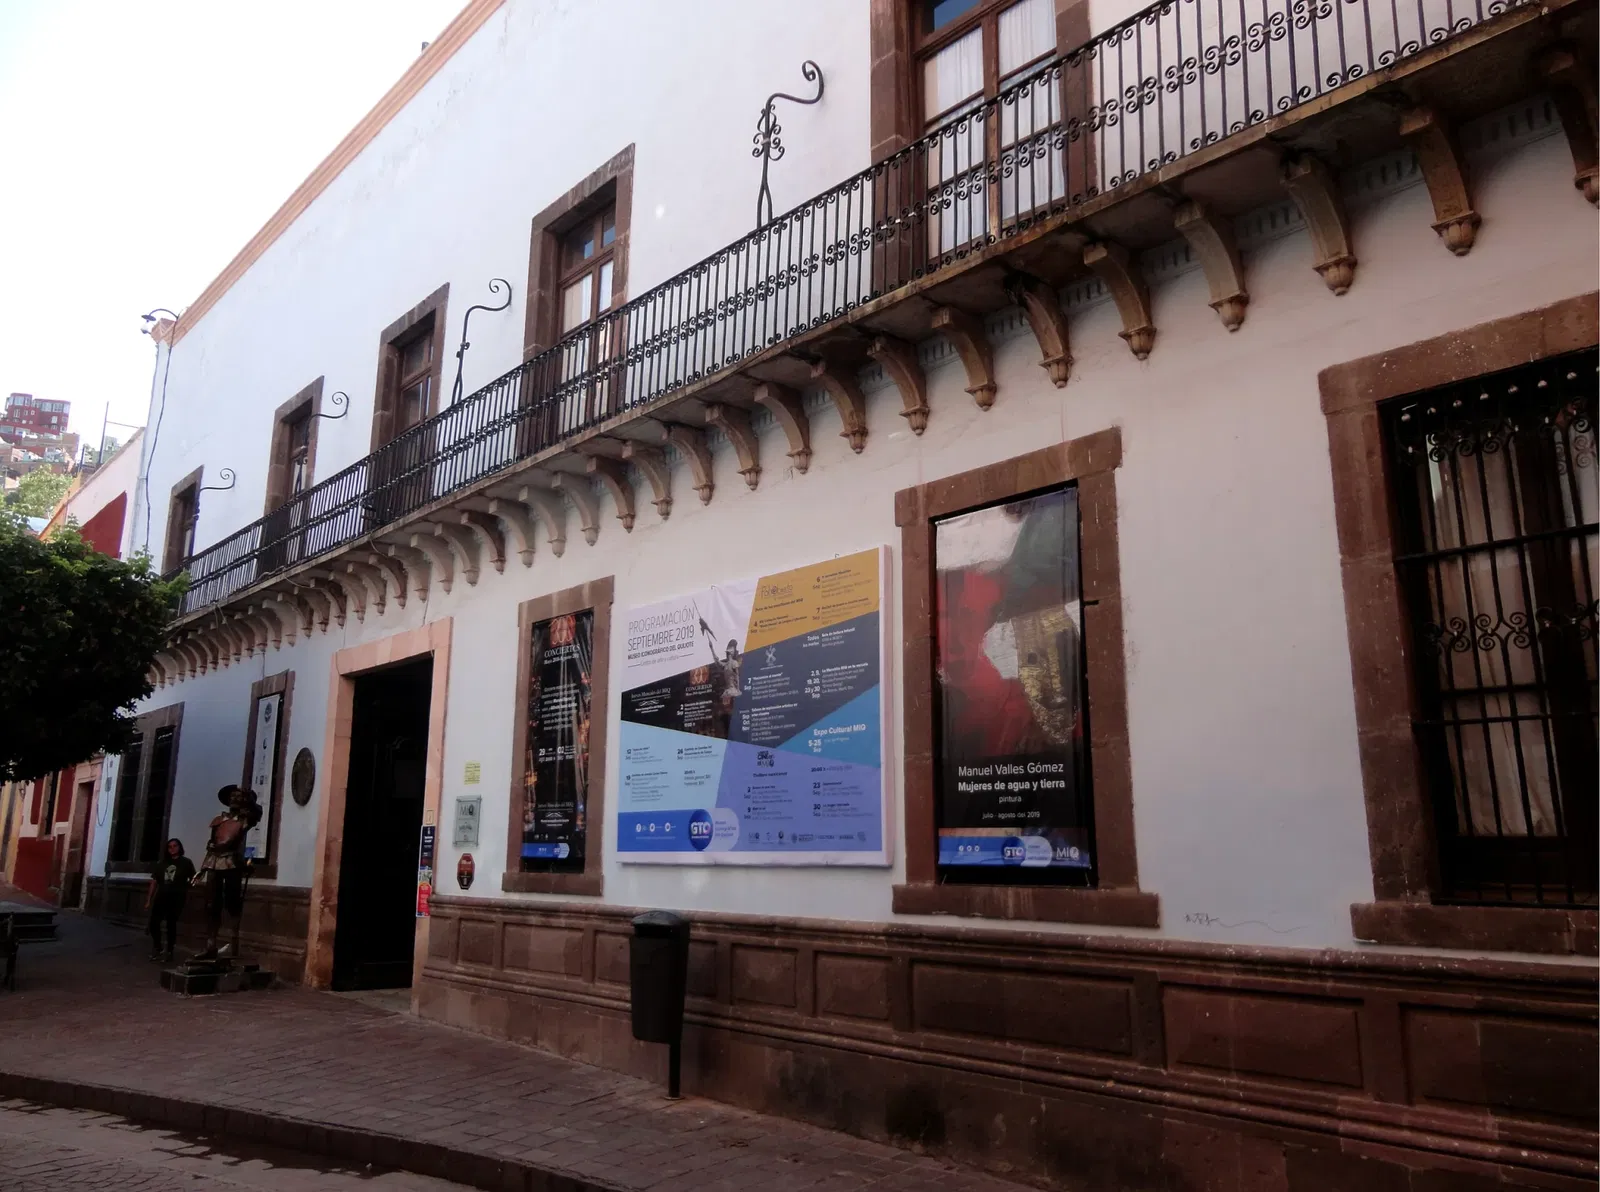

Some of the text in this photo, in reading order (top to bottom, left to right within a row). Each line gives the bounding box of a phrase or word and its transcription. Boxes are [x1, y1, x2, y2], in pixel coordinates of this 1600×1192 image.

[629, 605, 694, 635] PROGRAMACIÓN
[628, 625, 694, 651] SEPTIEMBRE 2019
[544, 643, 580, 658] CONCIERTOS
[628, 652, 640, 660] MUSEO
[677, 641, 694, 650] QUIJOTE
[685, 684, 712, 692] CONCIERTOS
[813, 728, 828, 736] Expo
[829, 725, 852, 734] Cultural
[808, 739, 821, 747] 5-25
[539, 748, 545, 756] 29
[958, 762, 1063, 777] Manuel Valles Gómez
[958, 779, 1065, 793] Mujeres de agua y tierra
[998, 795, 1022, 803] pintura
[982, 812, 993, 820] julio
[691, 822, 711, 835] GTO
[1003, 847, 1023, 857] GTO
